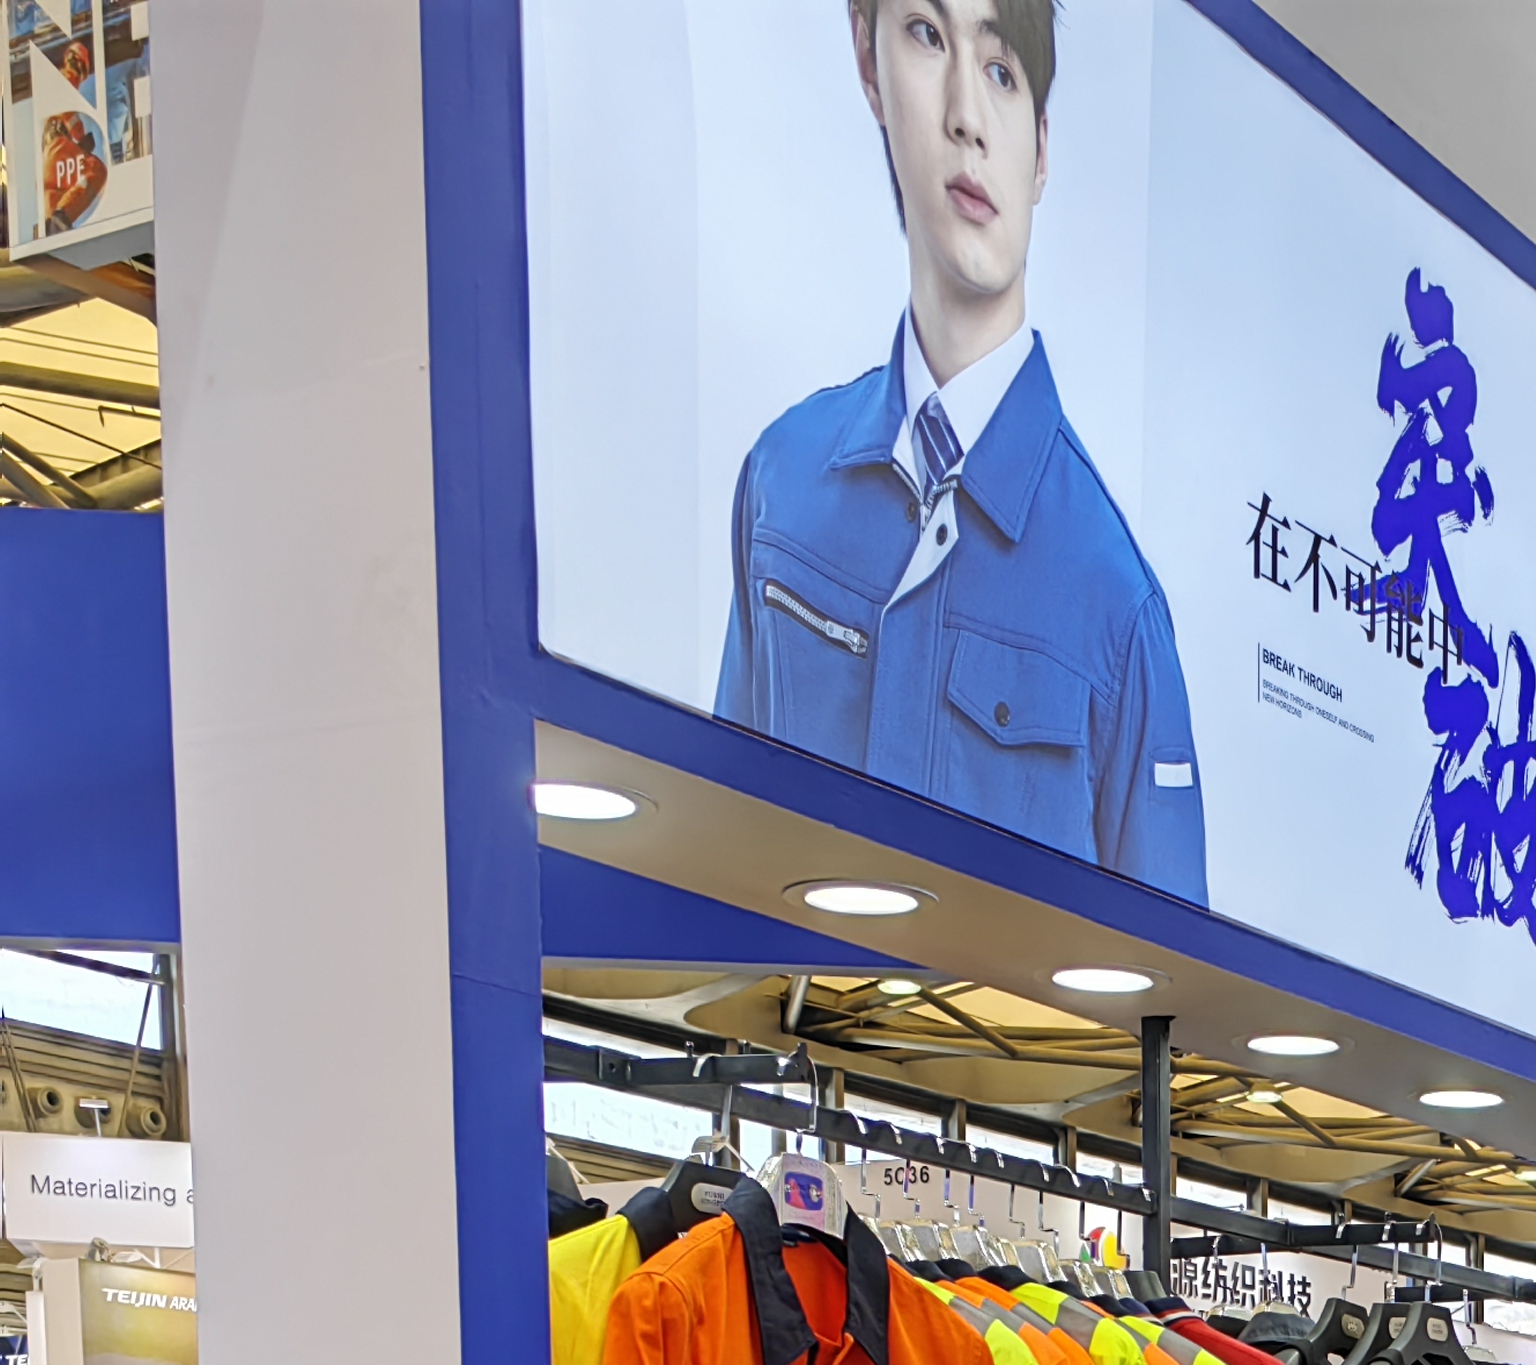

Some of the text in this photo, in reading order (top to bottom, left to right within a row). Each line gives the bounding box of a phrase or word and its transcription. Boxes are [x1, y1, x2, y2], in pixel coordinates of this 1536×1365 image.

[56, 154, 86, 188] PPE
[1245, 491, 1464, 685] 在不可能中
[1262, 648, 1343, 703] BREAK THROUGH
[1262, 679, 1289, 700] BREAKING
[1262, 692, 1275, 705] NEW
[31, 1174, 177, 1207] Materializing
[102, 1287, 168, 1308] TEIJIN
